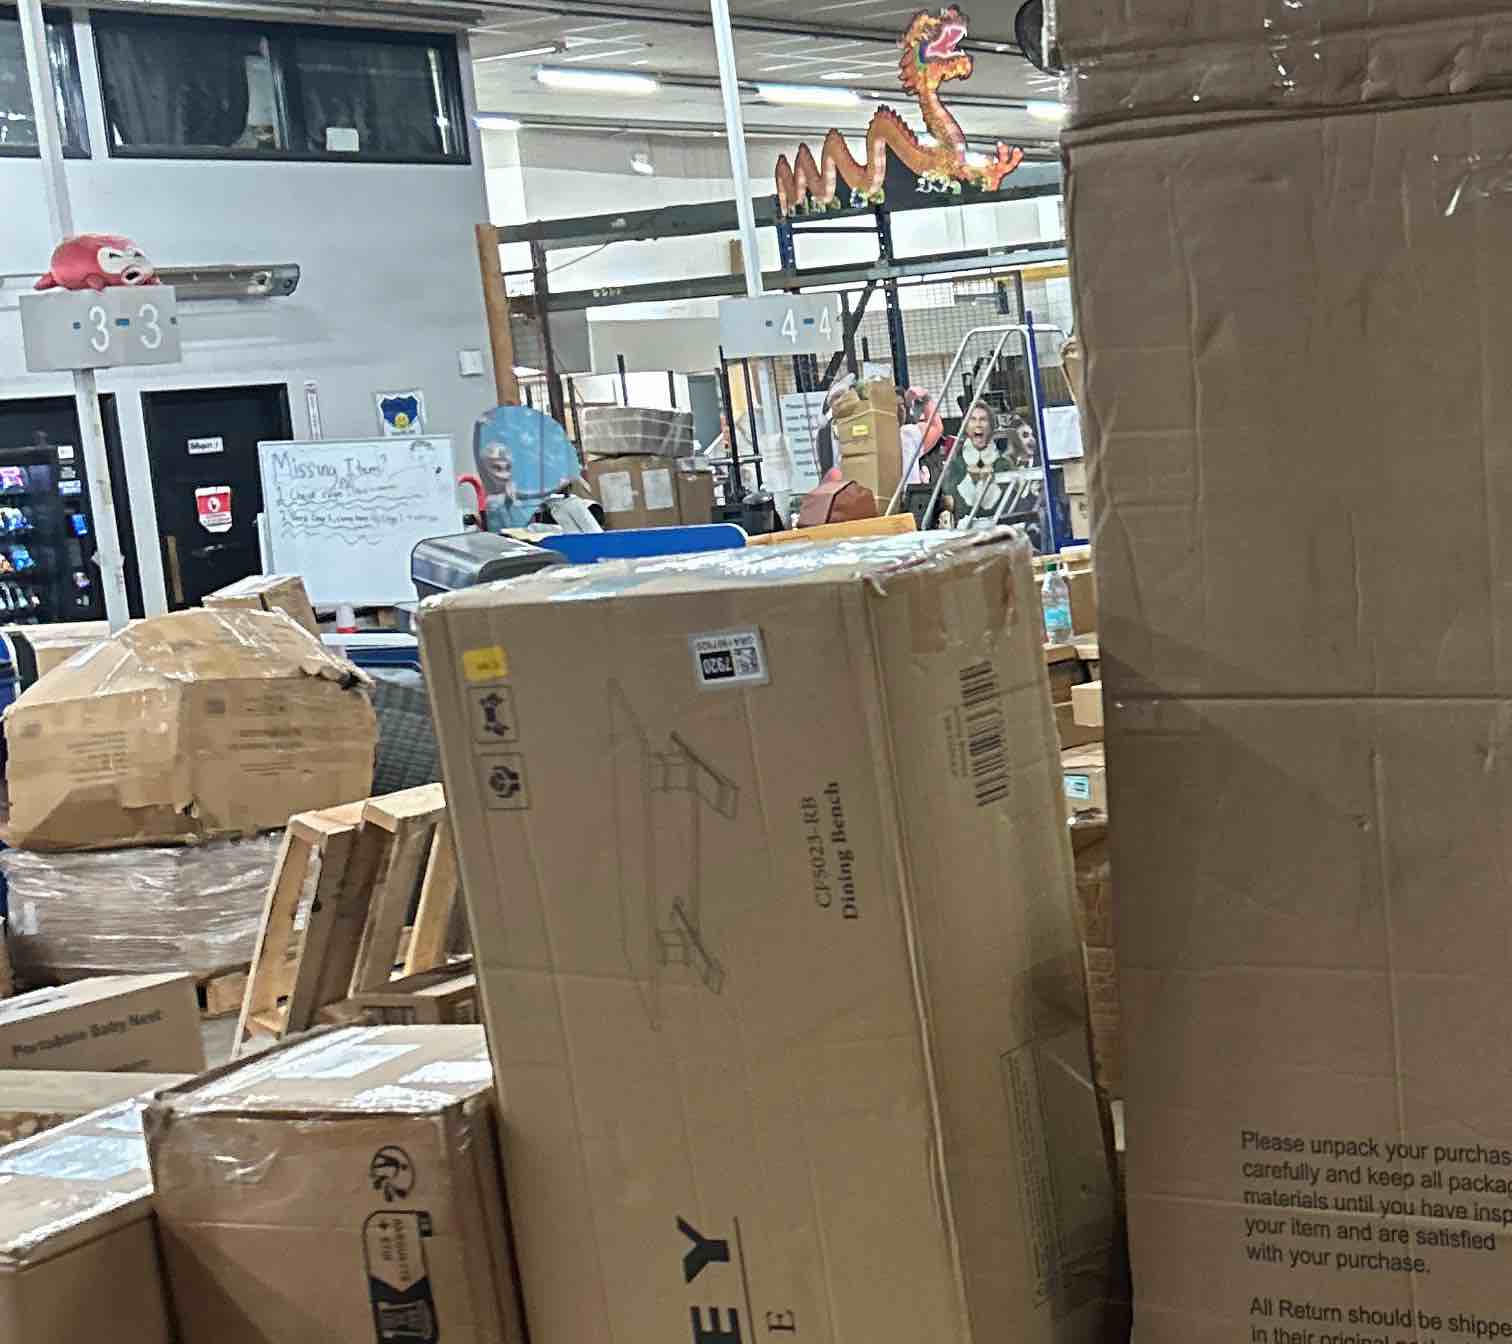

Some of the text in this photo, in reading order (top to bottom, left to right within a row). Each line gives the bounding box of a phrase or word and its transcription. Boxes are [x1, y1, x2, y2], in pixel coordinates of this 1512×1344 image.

[272, 450, 337, 483] Missing
[1241, 1130, 1304, 1153] Please
[1311, 1137, 1380, 1160] unpack
[1386, 1142, 1426, 1163] your
[1243, 1160, 1320, 1186] carefully
[1326, 1166, 1361, 1185] and
[1368, 1167, 1415, 1190] keep
[1421, 1171, 1443, 1190] all
[1244, 1189, 1329, 1211] materials
[1335, 1195, 1374, 1214] until
[1380, 1199, 1416, 1219] you
[1421, 1199, 1467, 1221] have
[1245, 1217, 1496, 1251] your item and are satisfied
[1246, 1242, 1431, 1274] with your purchase.
[1250, 1297, 1273, 1317] All
[1280, 1299, 1342, 1322] Return
[1348, 1306, 1412, 1328] should
[1418, 1311, 1442, 1330] be
[1252, 1325, 1268, 1344] in
